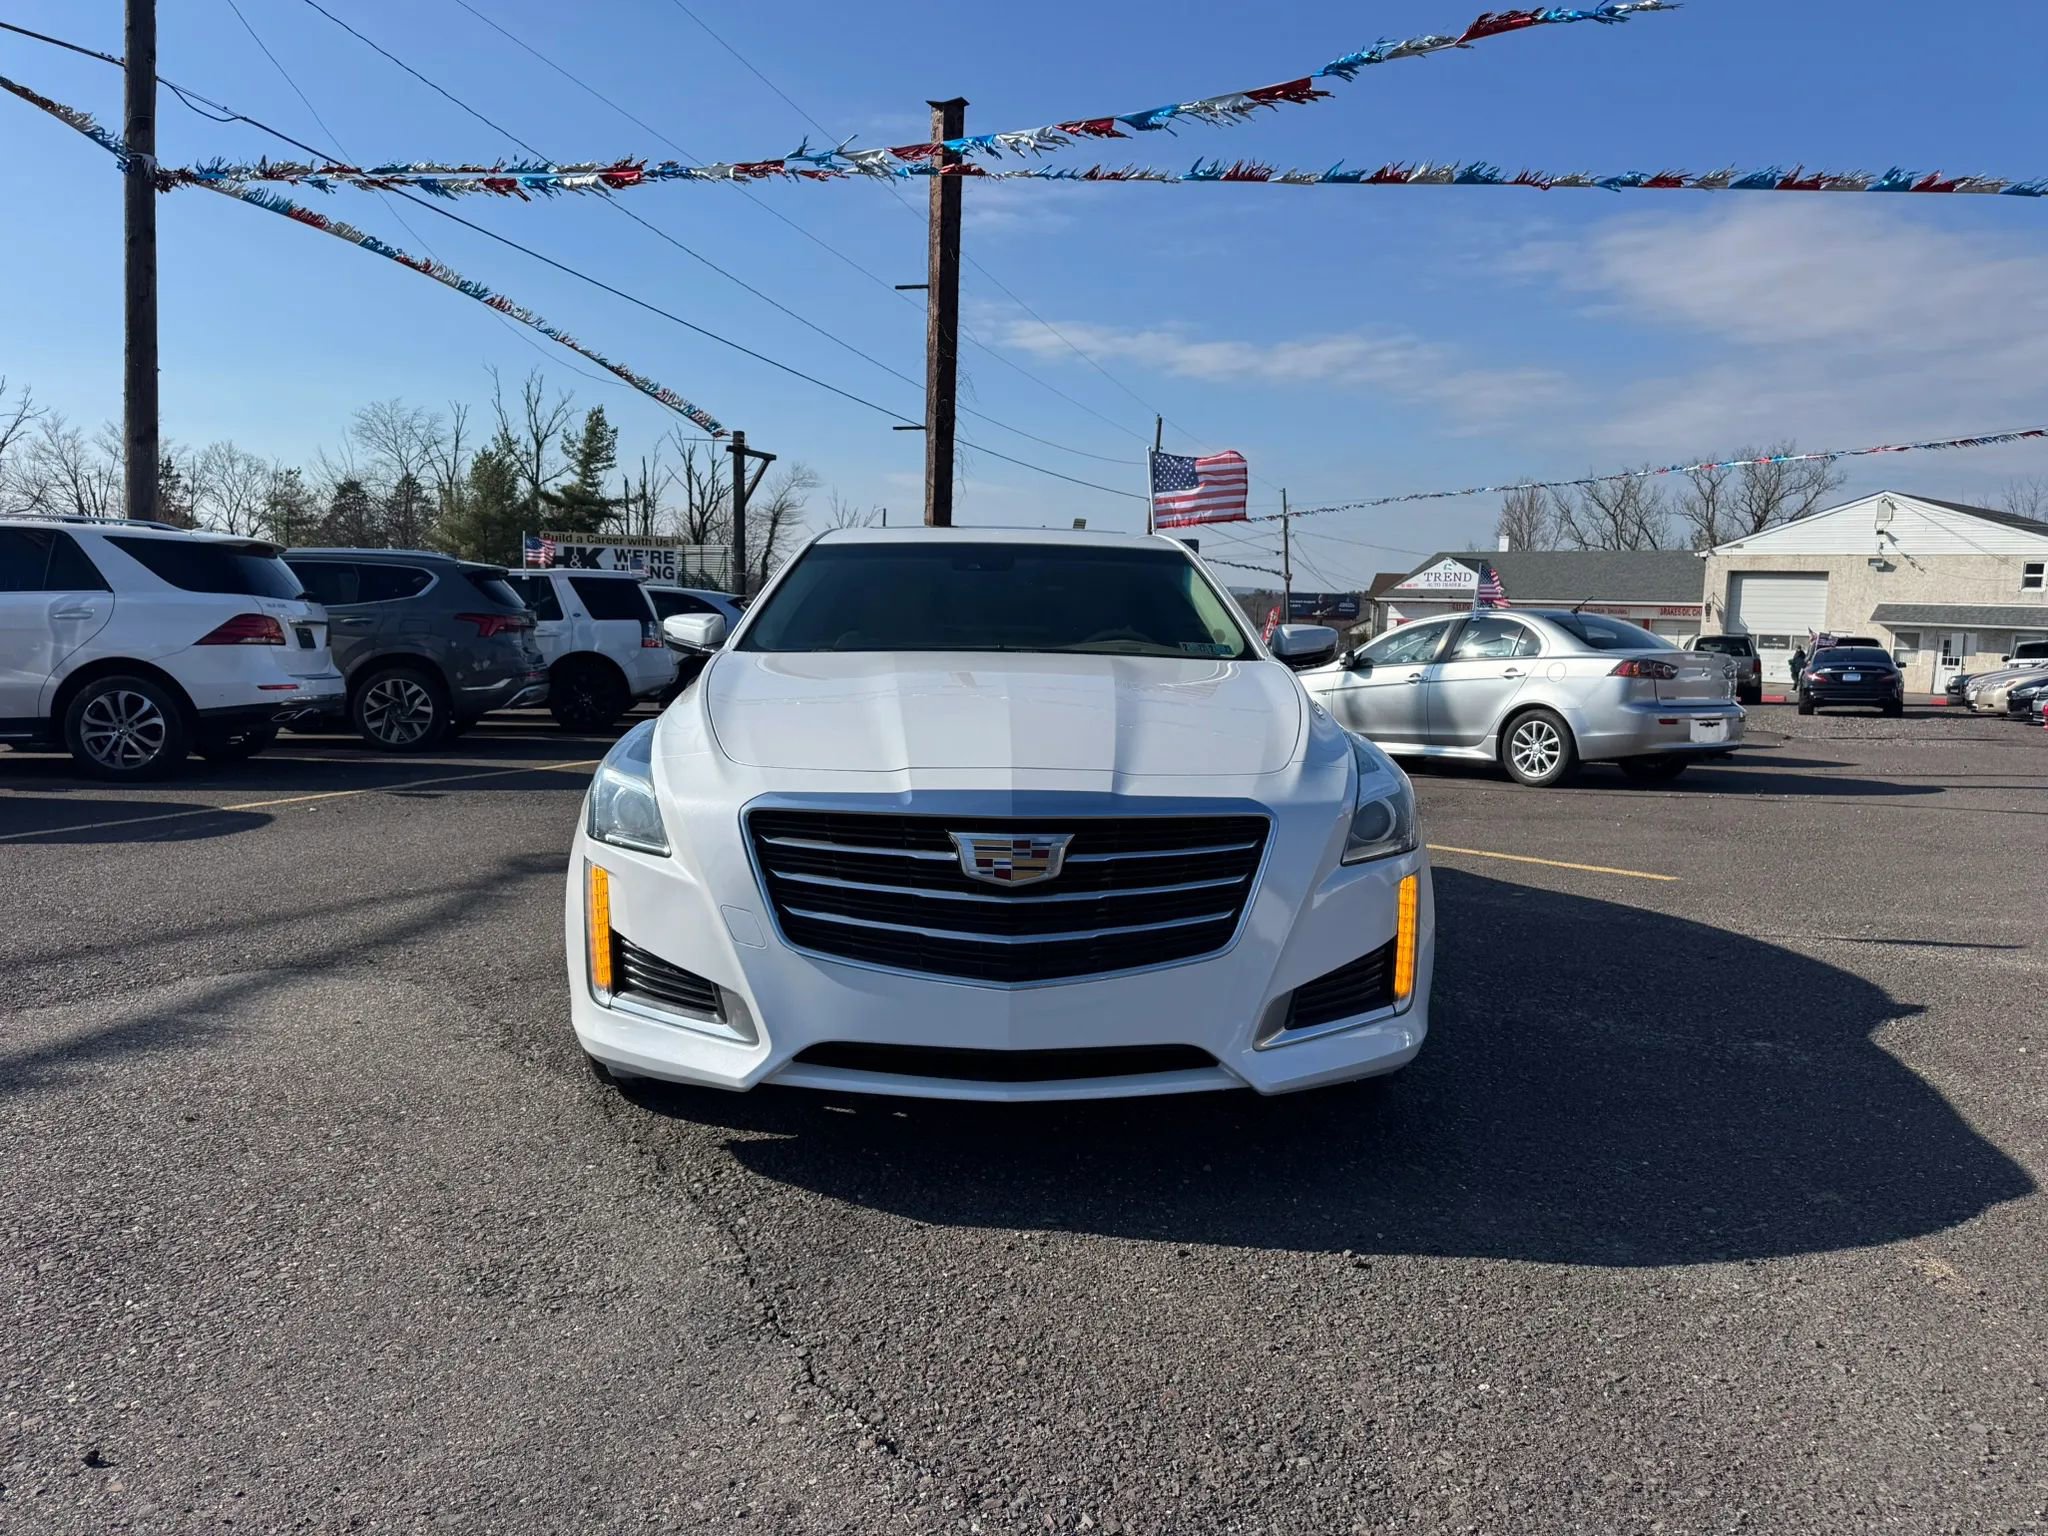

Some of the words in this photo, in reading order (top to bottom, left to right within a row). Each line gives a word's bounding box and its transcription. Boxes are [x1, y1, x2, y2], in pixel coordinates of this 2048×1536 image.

[576, 535, 583, 544] a
[586, 534, 624, 545] Career
[627, 537, 652, 547] with
[613, 548, 675, 565] WE'RE
[1423, 571, 1472, 583] TREND
[1659, 607, 1681, 617] BRAKES
